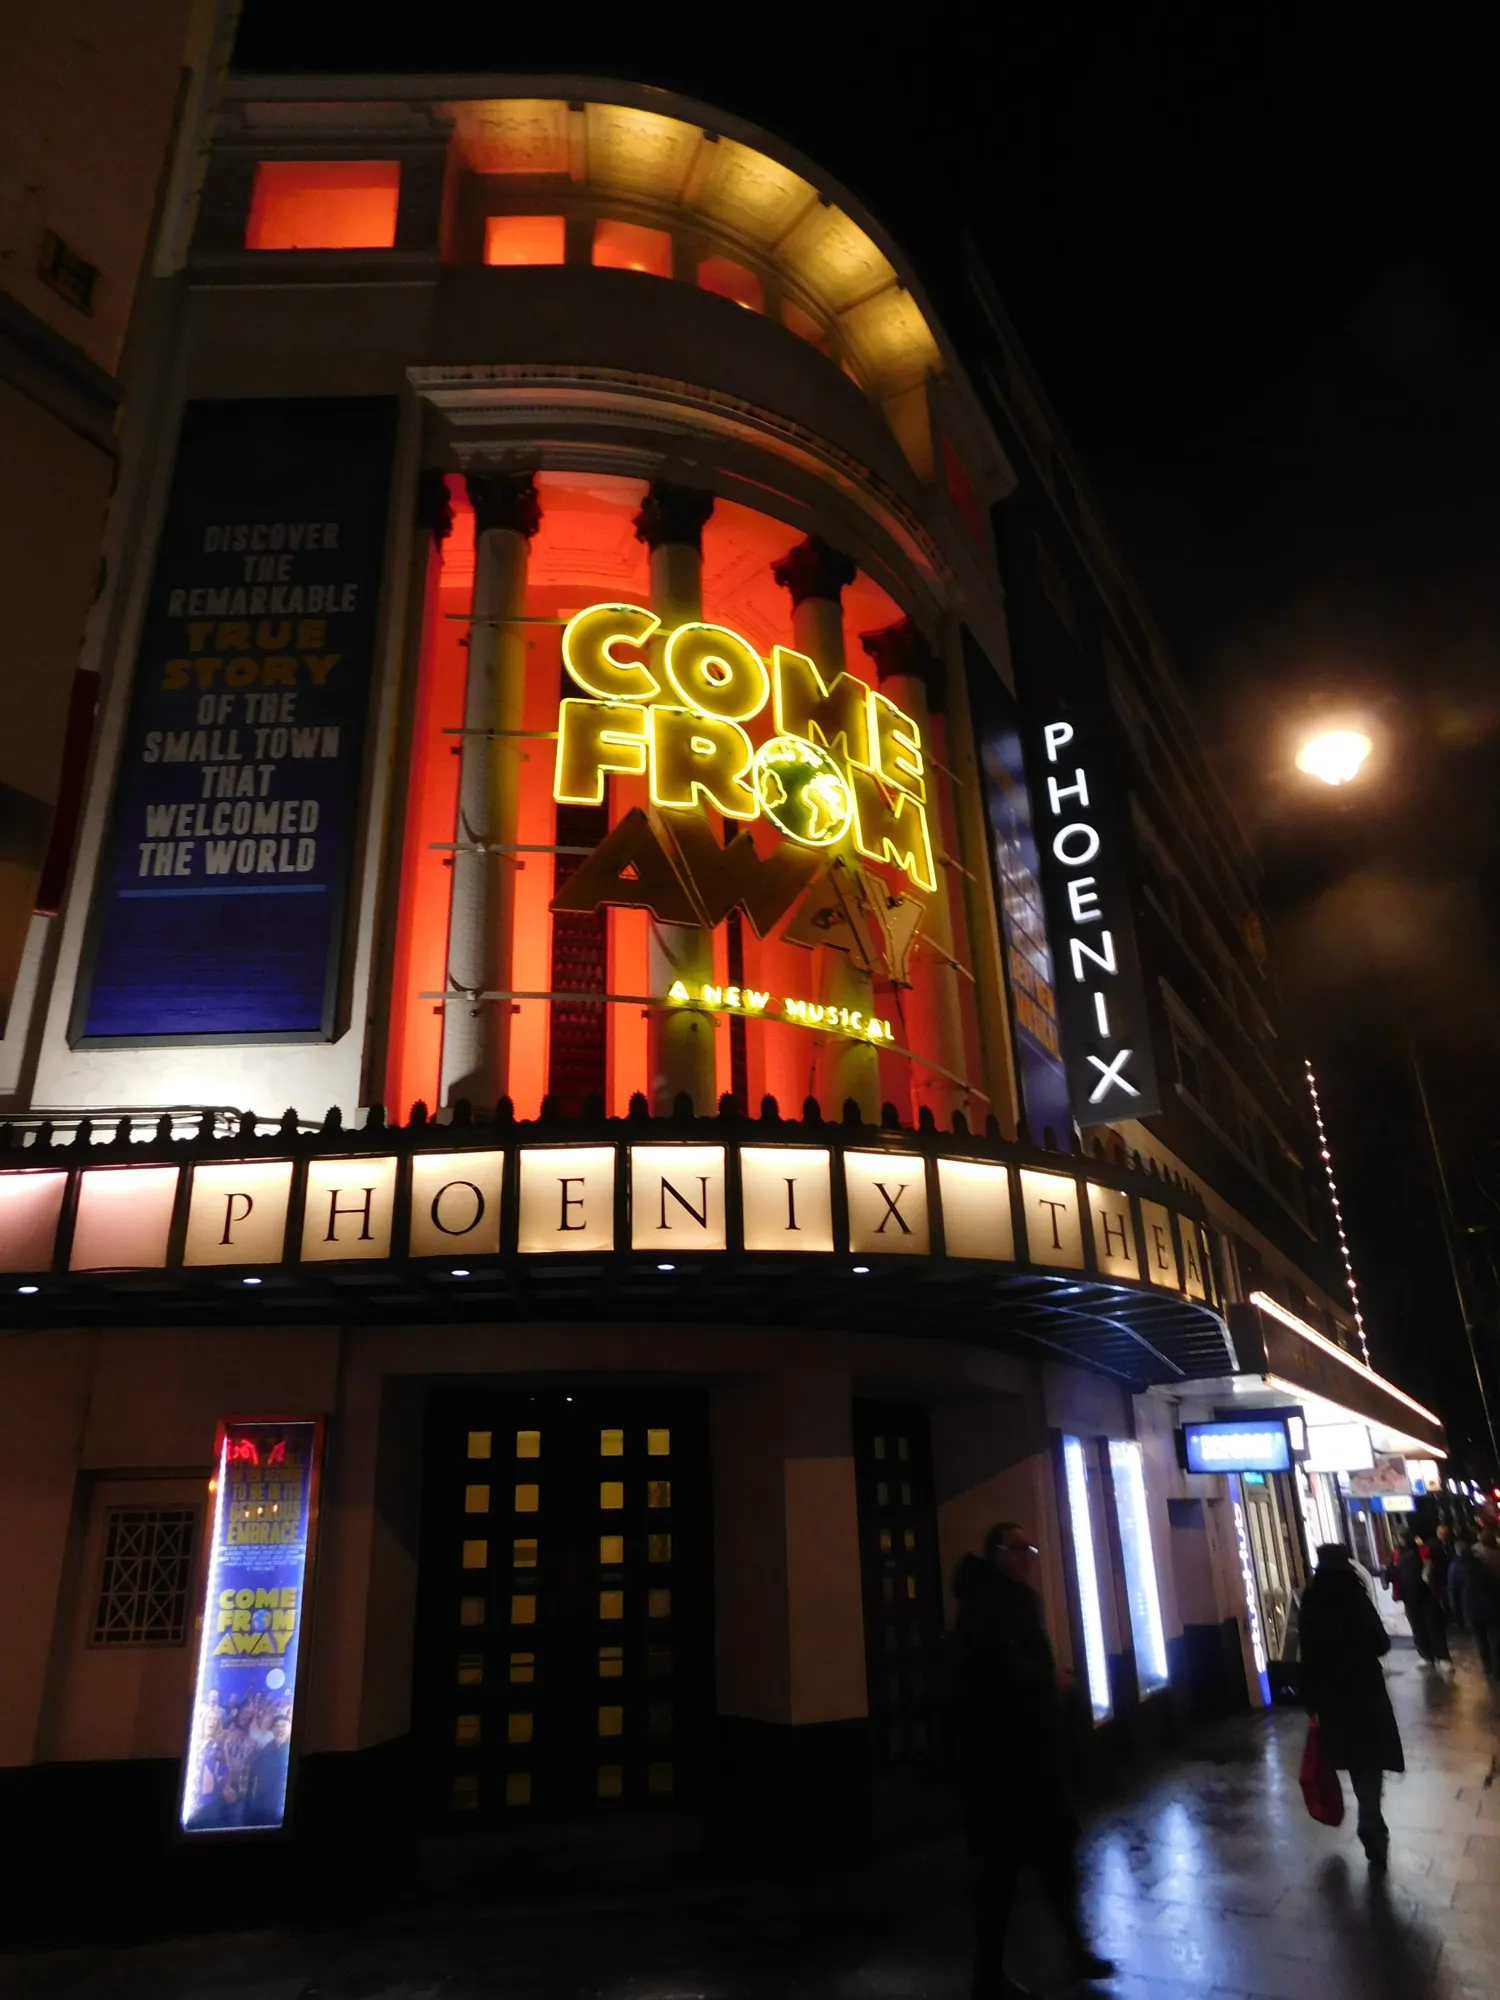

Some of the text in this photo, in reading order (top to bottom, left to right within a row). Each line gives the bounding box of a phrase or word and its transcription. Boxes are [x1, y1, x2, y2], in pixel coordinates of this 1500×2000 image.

[203, 523, 340, 553] DISCOVER
[243, 554, 295, 582] THE
[167, 583, 358, 617] REMARKABLE
[186, 619, 328, 652] TRUE
[161, 654, 343, 690] STORY
[197, 692, 298, 725] OF THE
[562, 602, 926, 803] COME
[142, 726, 341, 763] SMALL TOWN
[201, 764, 276, 799] THAT
[146, 800, 320, 838] WELCOMED
[138, 838, 316, 877] THE WORLD
[1044, 721, 1141, 1104] PHOENIX
[668, 980, 895, 1041] A NEW MUSICAL
[218, 1175, 1201, 1283] PHOENIX THEA
[227, 1522, 302, 1545] EMBRACE
[218, 1587, 297, 1610] COME
[217, 1609, 296, 1632] FROM
[213, 1630, 294, 1656] AWAY
